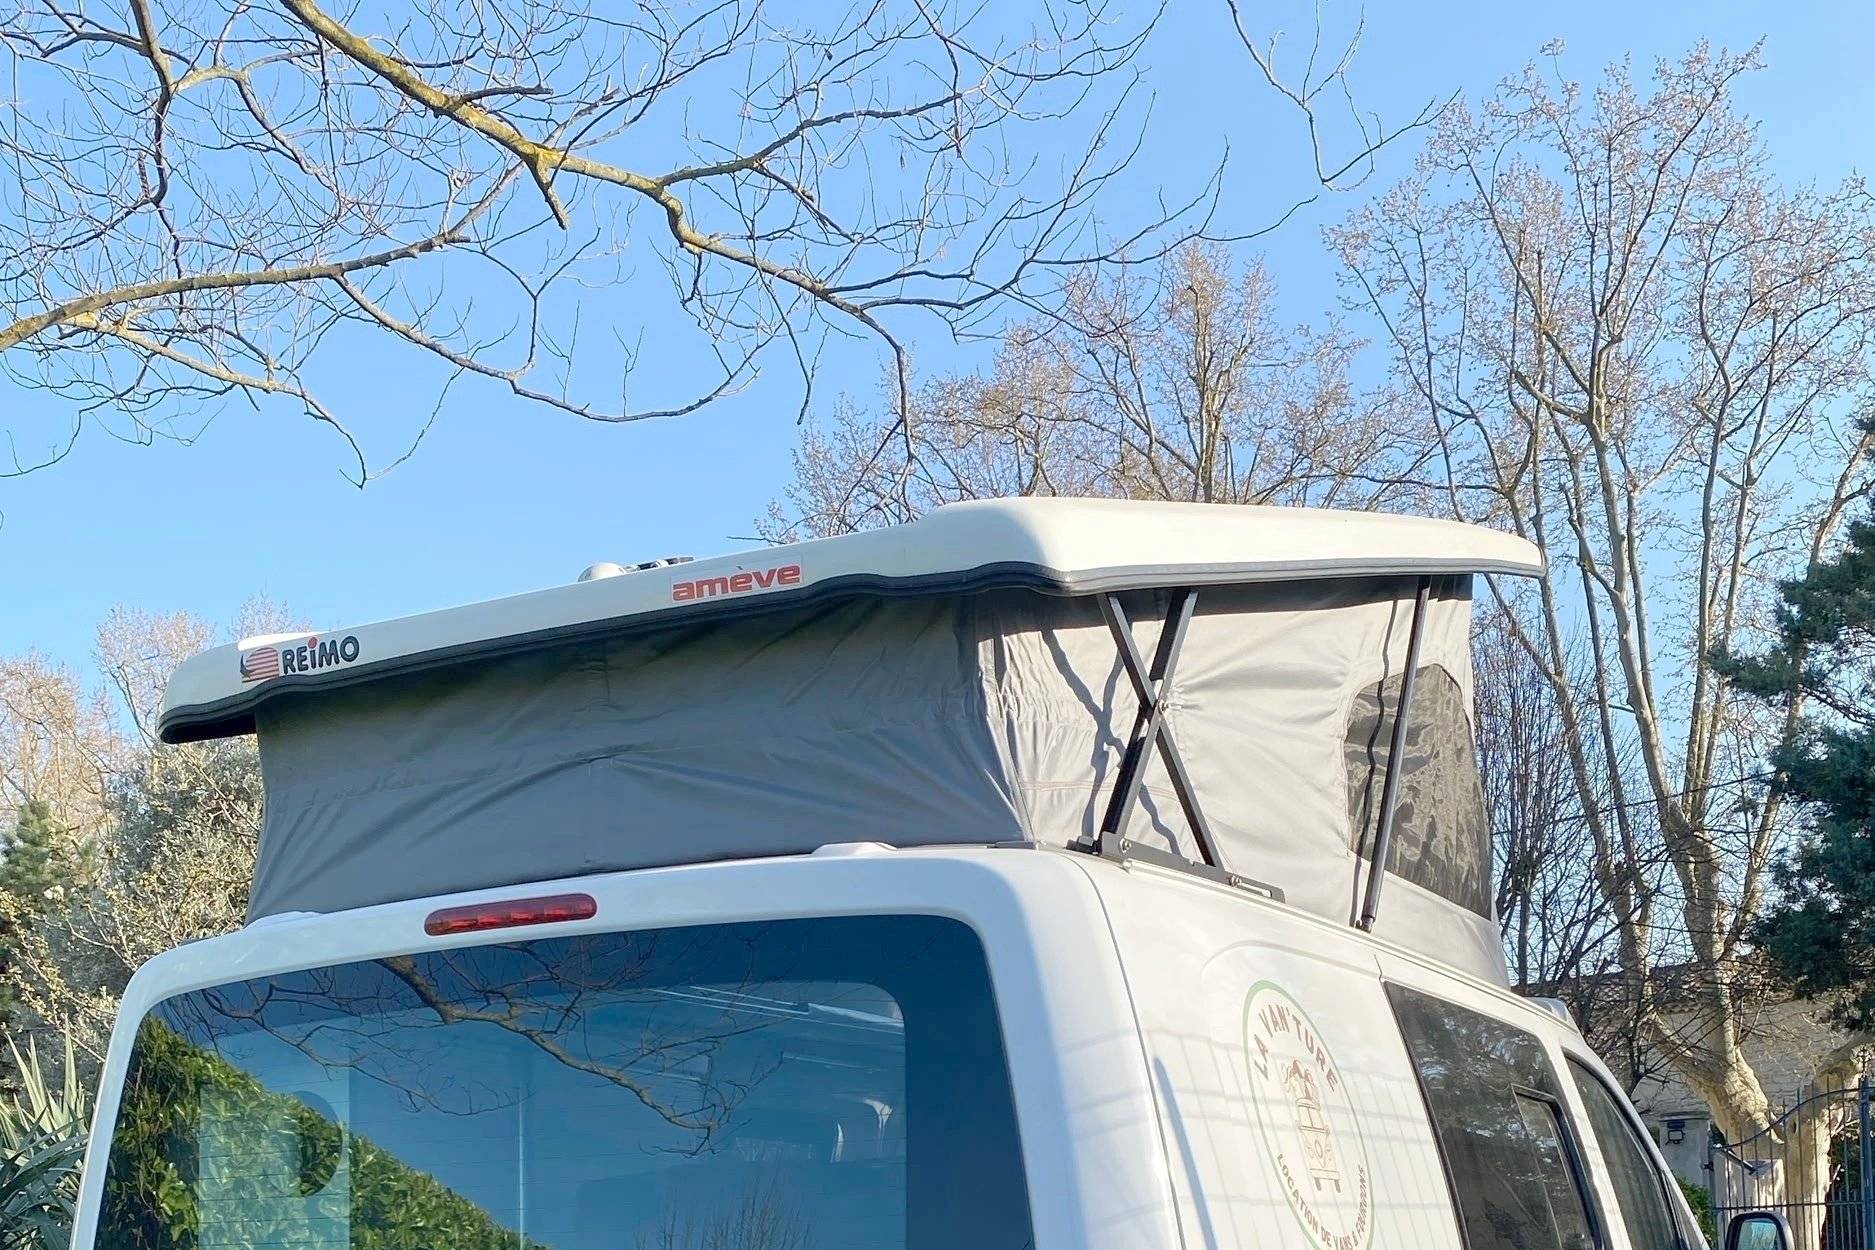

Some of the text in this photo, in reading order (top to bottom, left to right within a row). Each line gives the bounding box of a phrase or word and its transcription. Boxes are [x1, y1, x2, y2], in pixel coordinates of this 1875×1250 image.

[1254, 1004, 1338, 1093] LA VAN'TURE
[1277, 1153, 1319, 1234] LOCATION
[1321, 1226, 1332, 1248] DE
